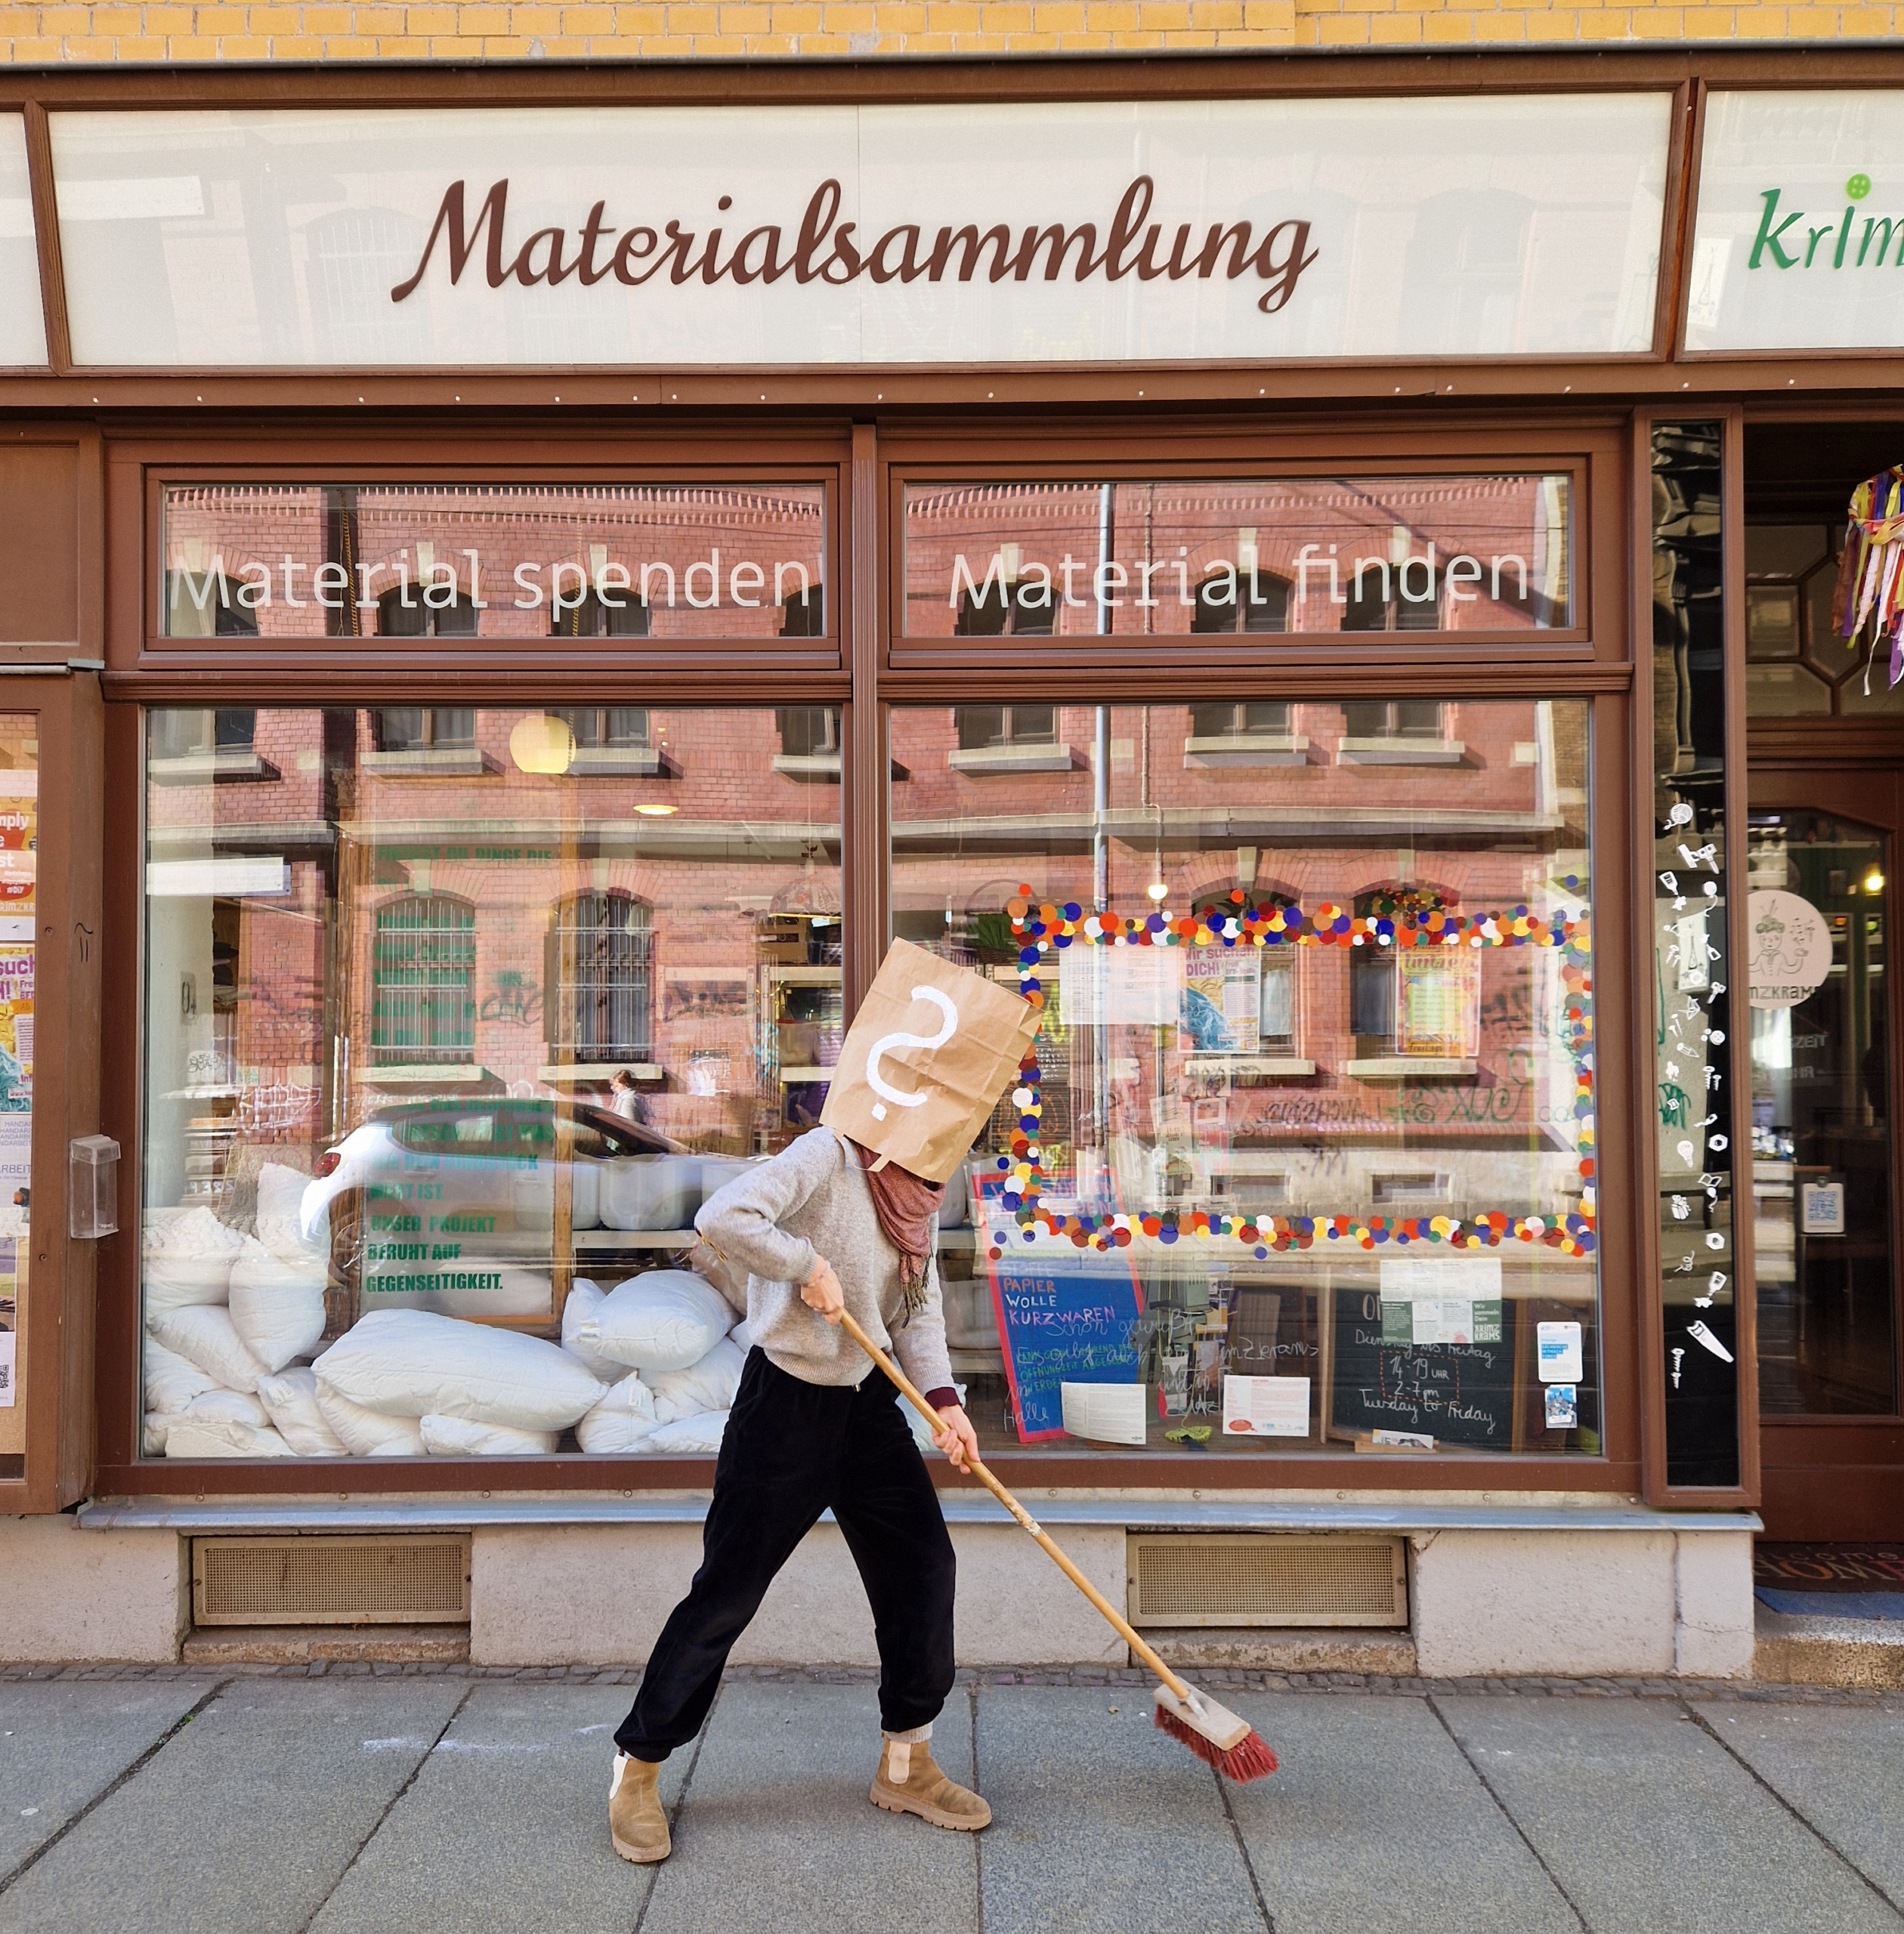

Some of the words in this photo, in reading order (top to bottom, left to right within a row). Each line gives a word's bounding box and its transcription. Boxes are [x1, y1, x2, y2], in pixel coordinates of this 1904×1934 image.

[391, 174, 1320, 314] Materialsammlung
[948, 544, 1268, 610] Material
[1291, 541, 1528, 604] finden
[169, 548, 488, 610] Material
[513, 547, 810, 623] spenden
[1186, 962, 1220, 977] DICH!
[370, 1182, 414, 1200] WERT
[417, 1183, 445, 1200] IST.
[371, 1215, 422, 1232] UNSER
[428, 1216, 496, 1233] PROJEKT
[367, 1244, 428, 1261] BERUHT
[431, 1244, 462, 1261] AUF
[366, 1273, 503, 1293] GEGENSEITIGKEIT.
[1003, 1277, 1057, 1293] PAPIER
[1005, 1293, 1057, 1308] WOLLE
[1009, 1304, 1116, 1327] KURZWAREN
[1431, 1369, 1450, 1380] UHR
[1358, 1388, 1418, 1424] Tuesday
[1448, 1400, 1496, 1435] Friday
[1754, 1552, 1899, 1561] elcome
